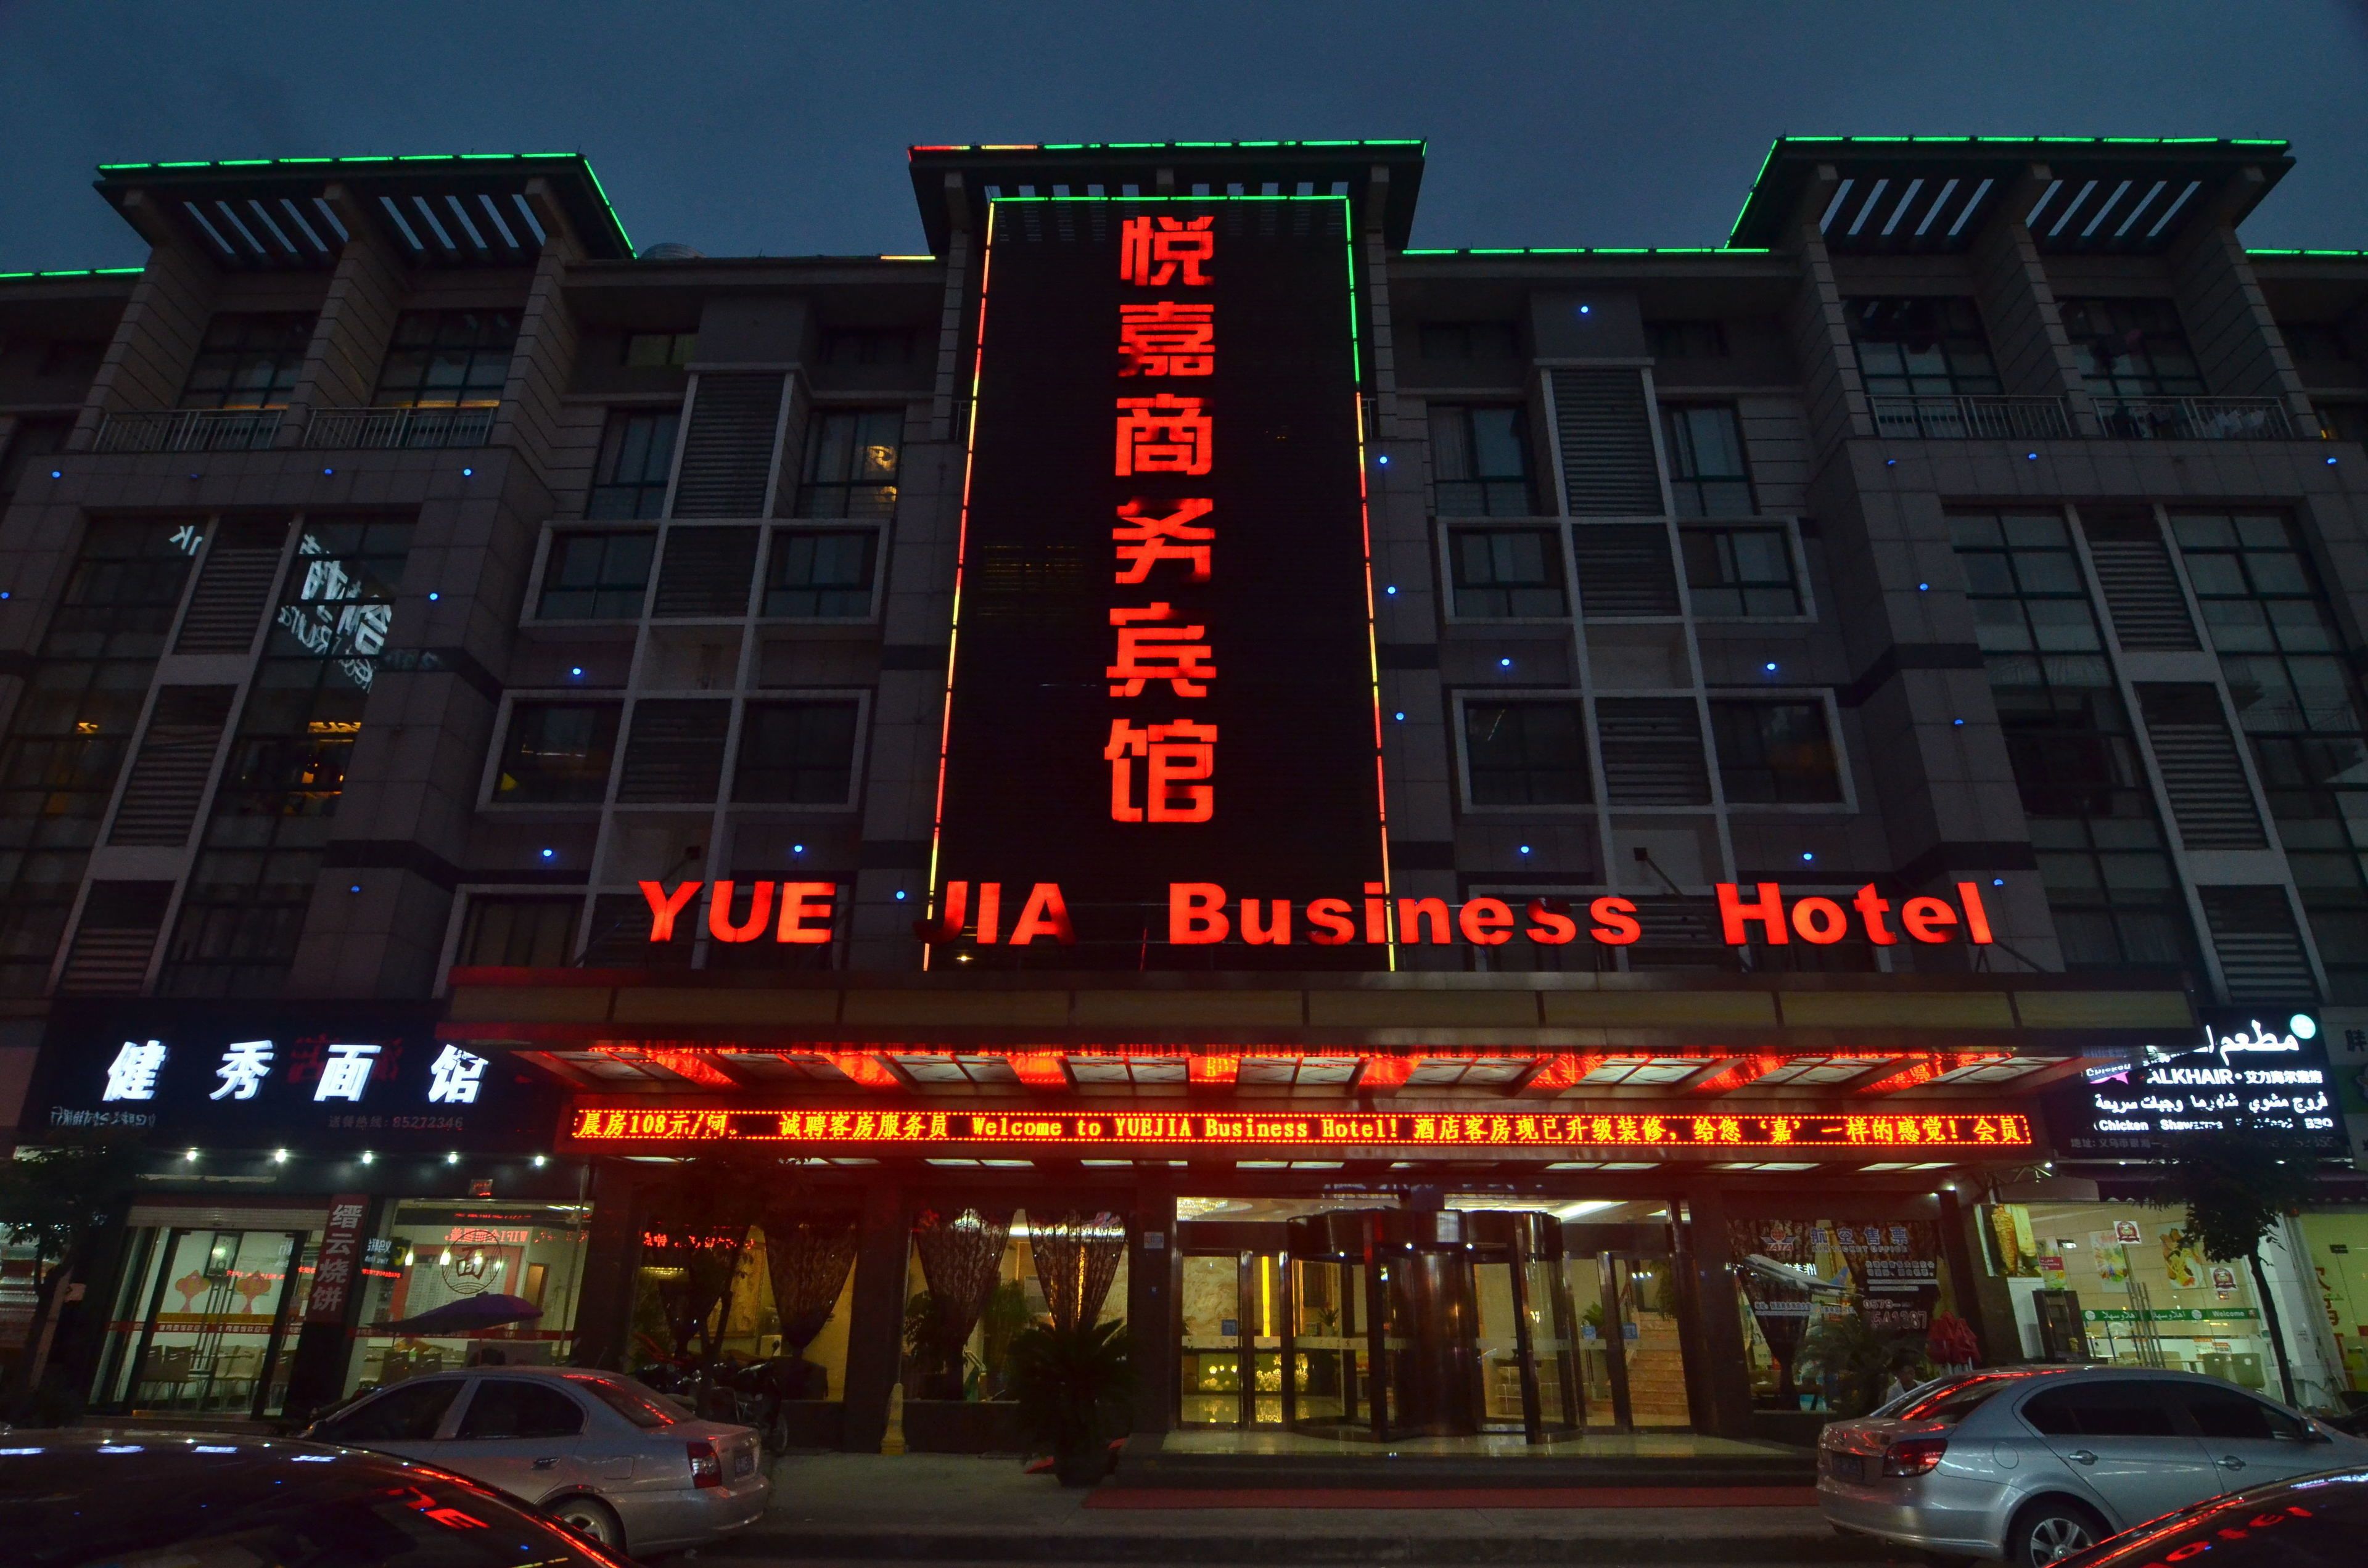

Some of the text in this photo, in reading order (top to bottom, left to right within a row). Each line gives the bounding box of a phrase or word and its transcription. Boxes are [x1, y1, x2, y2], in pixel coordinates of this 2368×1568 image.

[1103, 213, 1219, 824] 悦嘉商务宾馆
[638, 880, 1994, 945] YUE JIA Business Hotel
[102, 1040, 491, 1104] 健秀面馆
[2220, 1019, 2300, 1066] مطعم
[779, 1114, 948, 1138] 诚聘客房服务员
[972, 1117, 1063, 1136] Welcome
[1076, 1119, 1101, 1136] to
[1115, 1117, 1191, 1137] YUEJIA
[1205, 1117, 1308, 1138] Business
[1322, 1117, 1399, 1138] Hotel!
[312, 1204, 363, 1311] 缙云烧饼
[1810, 1226, 1909, 1246] 航空售票
